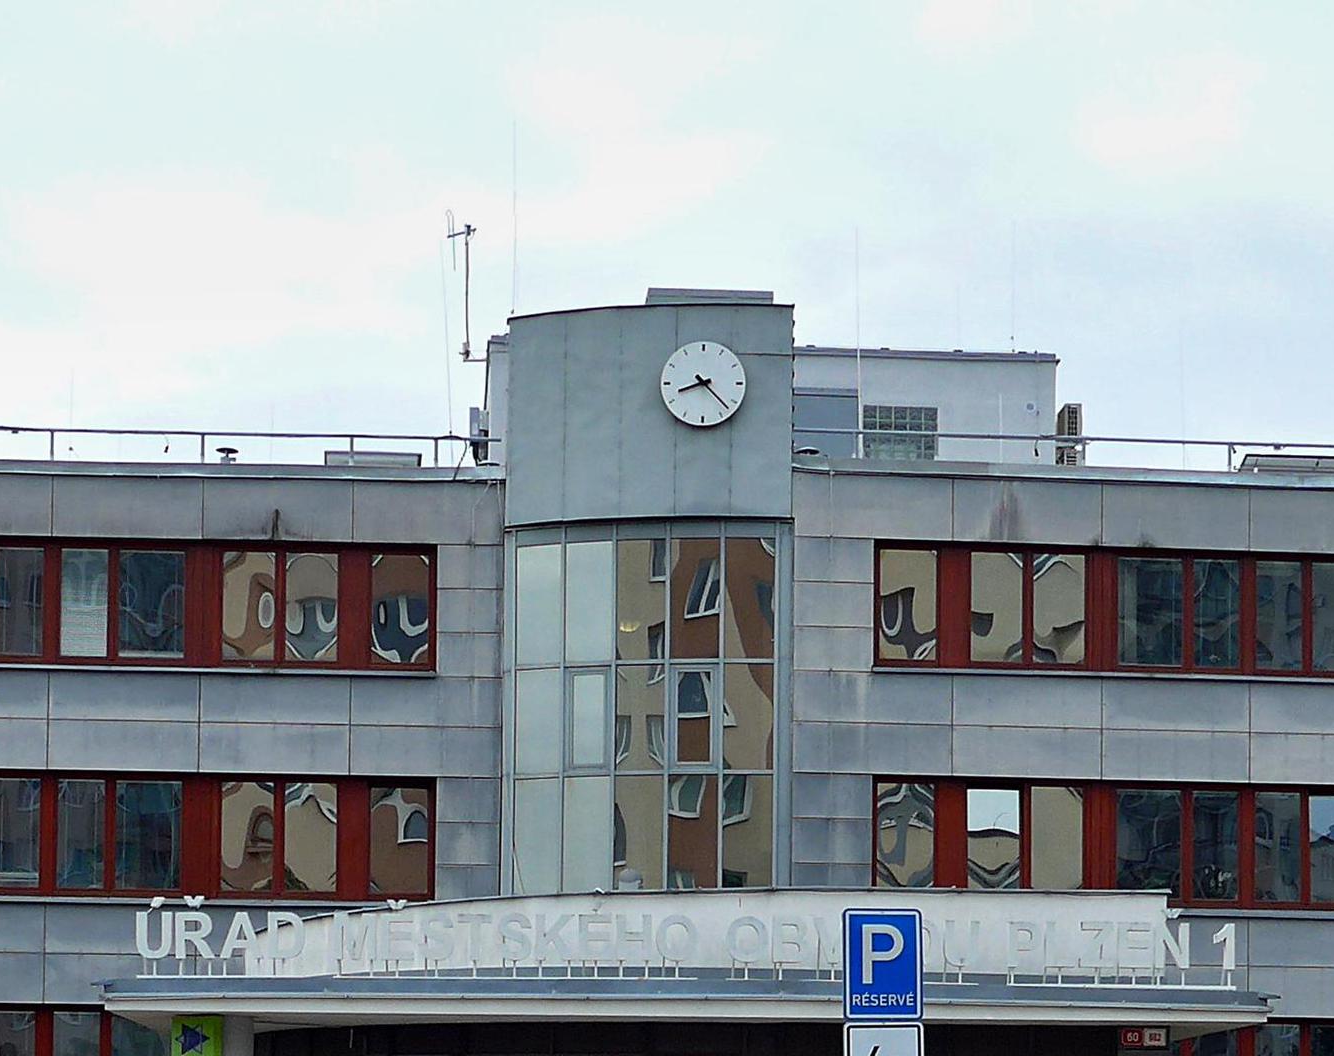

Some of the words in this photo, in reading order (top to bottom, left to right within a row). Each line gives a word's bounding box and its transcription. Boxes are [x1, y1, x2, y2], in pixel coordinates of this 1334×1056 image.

[136, 896, 306, 960] ÚŘAD
[332, 888, 700, 962] MĚSTSKÉHO
[725, 914, 981, 967] OBVU
[1007, 908, 1200, 970] PLZEŇ
[1212, 922, 1237, 971] 1
[861, 923, 905, 985] P
[852, 991, 915, 1007] RÉSERVÉ
